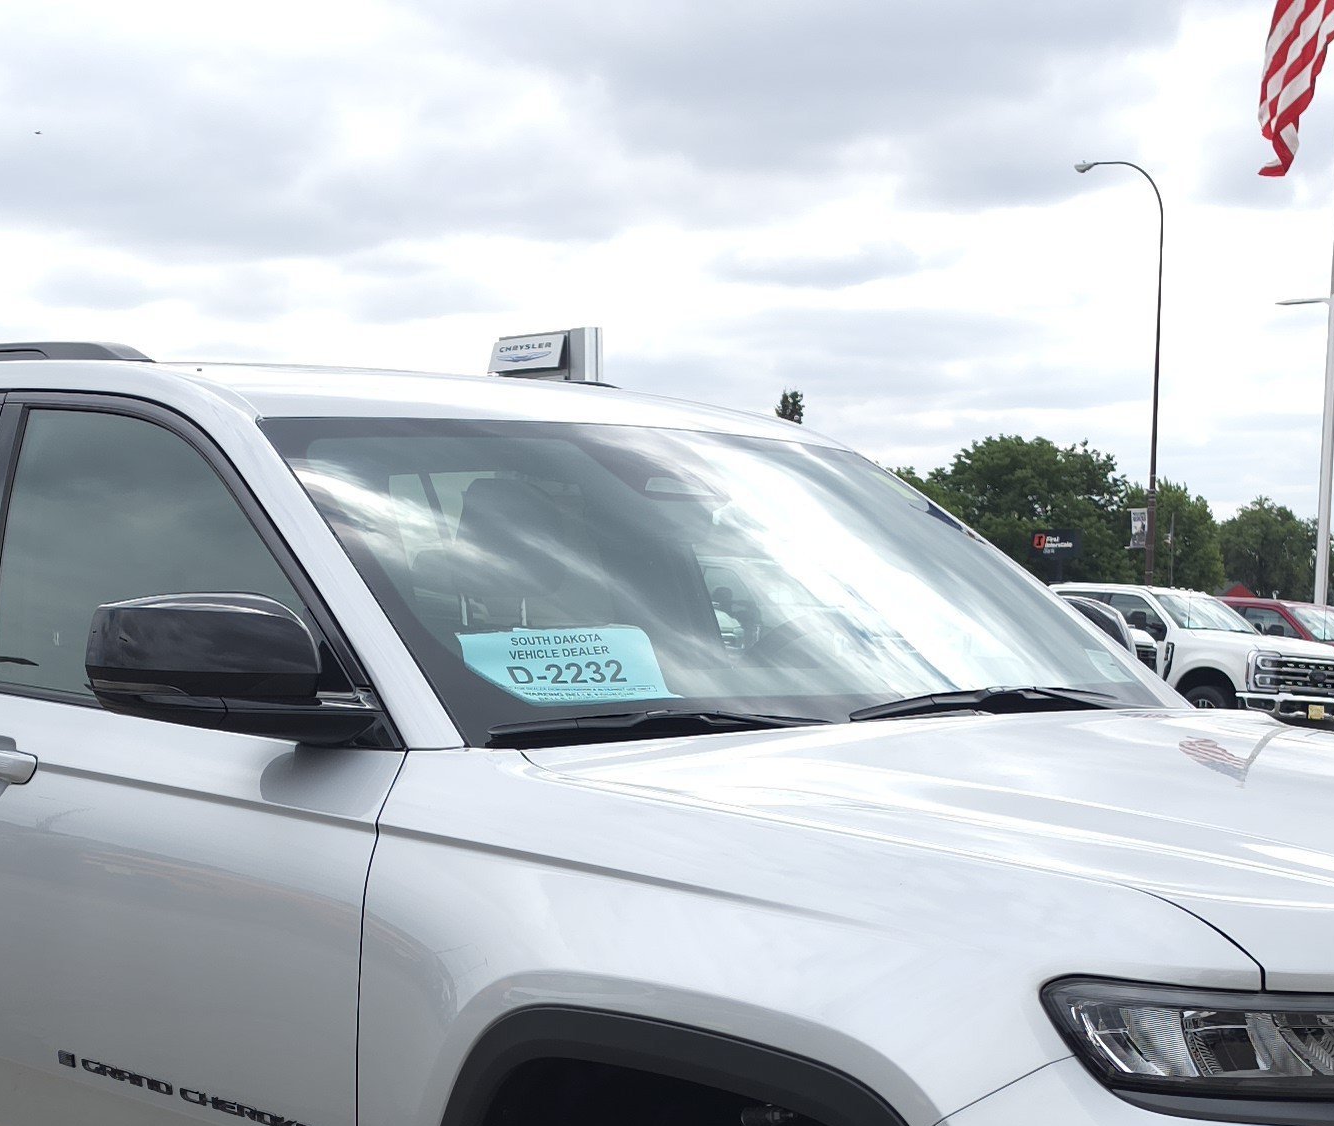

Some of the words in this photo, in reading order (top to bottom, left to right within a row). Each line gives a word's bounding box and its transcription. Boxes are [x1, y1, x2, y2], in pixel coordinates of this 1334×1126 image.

[499, 341, 552, 353] CHRYSLER
[510, 635, 551, 646] SOUTH
[553, 633, 603, 645] DAKOTA
[508, 648, 560, 660] VEHICLE
[561, 645, 610, 658] DEALER
[506, 660, 628, 684] D-2232
[81, 1058, 173, 1095] GRAND
